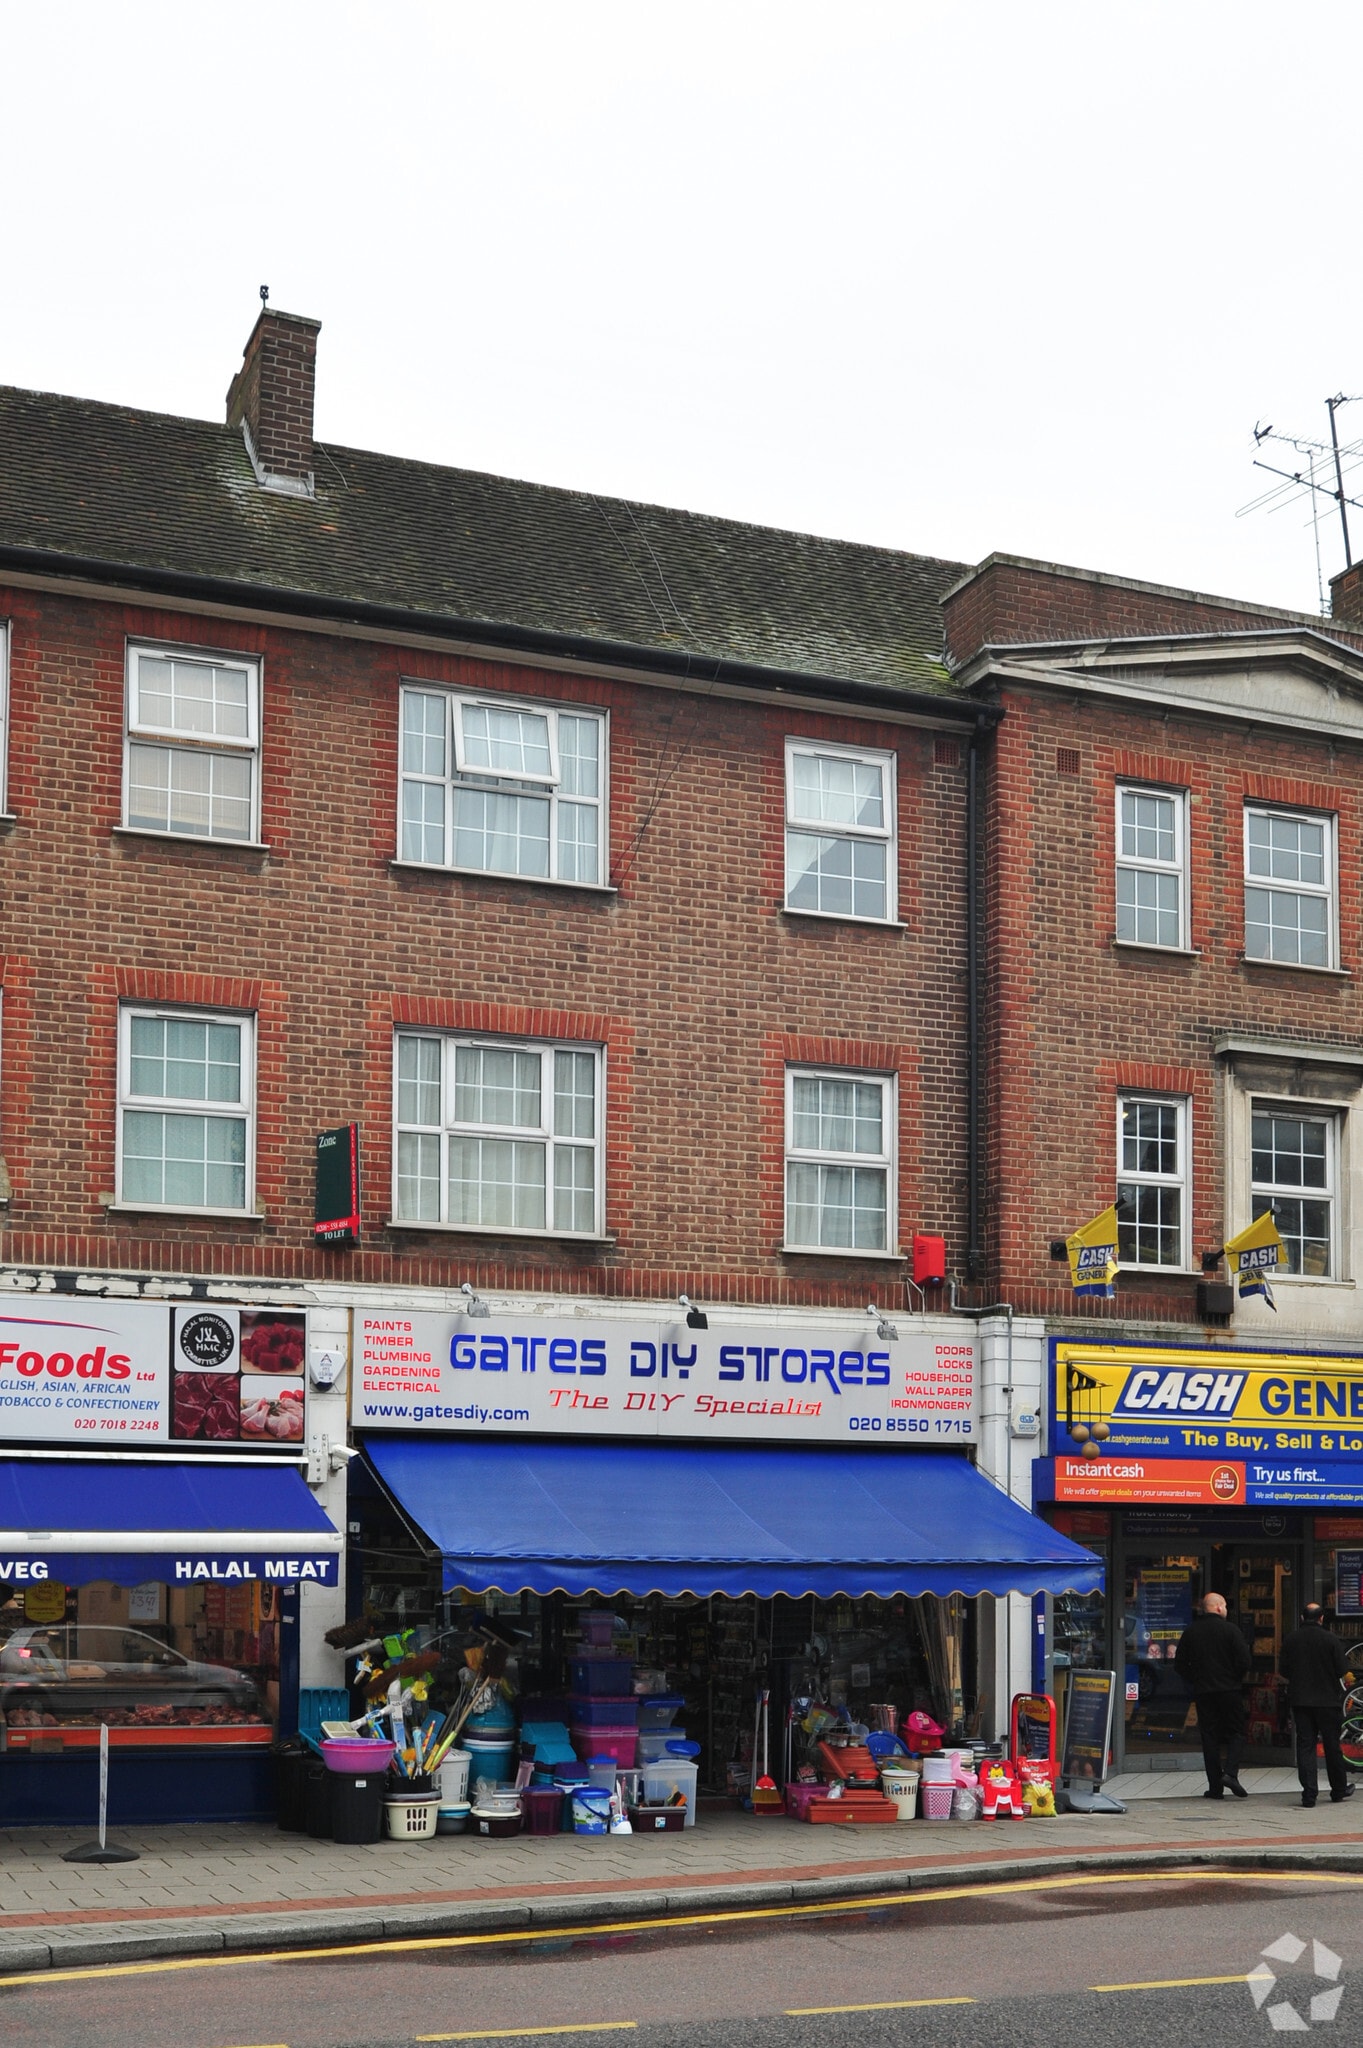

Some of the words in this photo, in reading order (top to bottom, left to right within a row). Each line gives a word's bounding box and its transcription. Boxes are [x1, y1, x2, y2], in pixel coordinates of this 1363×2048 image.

[324, 1231, 333, 1240] TO
[334, 1229, 345, 1238] LET
[1240, 1246, 1277, 1268] CASH
[364, 1320, 412, 1332] PAINTS
[364, 1335, 413, 1347] TIMBER
[196, 1344, 220, 1352] HMC
[935, 1346, 973, 1356] DOORS
[364, 1350, 431, 1362] PLUMBING
[630, 1341, 697, 1378] DIY
[0, 1344, 132, 1380] Foods
[136, 1372, 156, 1381] Ltd
[937, 1360, 973, 1370] LOCKS
[364, 1366, 440, 1378] GARDENING
[905, 1372, 972, 1383] HOUSEHOLD
[0, 1380, 38, 1392] GLISH,
[42, 1382, 79, 1393] ASIAN,
[82, 1384, 131, 1394] AFRICAN
[363, 1381, 440, 1393] ELECTRICAL
[1124, 1370, 1244, 1412] CASH
[1260, 1378, 1363, 1418] GENE
[55, 1398, 63, 1408] &
[66, 1398, 160, 1410] CONFECTIONERY
[550, 1390, 609, 1410] The
[624, 1393, 685, 1412] DIY
[694, 1394, 822, 1417] Specialist
[891, 1399, 972, 1410] IRONMONGERY
[364, 1405, 529, 1424] www.gatesdiy.com
[74, 1419, 96, 1429] 020
[100, 1420, 126, 1430] 7018
[130, 1420, 159, 1430] 2248
[849, 1417, 881, 1432] 020
[886, 1418, 929, 1432] 8550
[934, 1420, 972, 1433] 1715
[1181, 1430, 1219, 1446] The
[1226, 1432, 1269, 1451] Buy,
[1276, 1433, 1312, 1449] Sell
[1320, 1435, 1334, 1450] &
[1066, 1461, 1112, 1477] Instant
[1113, 1464, 1144, 1478] cash
[1254, 1466, 1274, 1484] Try
[1280, 1471, 1291, 1481] us
[1294, 1468, 1326, 1482] first...
[1064, 1487, 1074, 1495] We
[1086, 1488, 1100, 1496] offer
[1100, 1489, 1116, 1498] great
[1156, 1490, 1185, 1498] unwanted
[1186, 1490, 1201, 1498] items
[1274, 1492, 1294, 1501] quality
[1295, 1493, 1319, 1501] products
[0, 1561, 48, 1579] VEG
[176, 1561, 256, 1579] HALAL
[265, 1561, 330, 1578] MEAT
